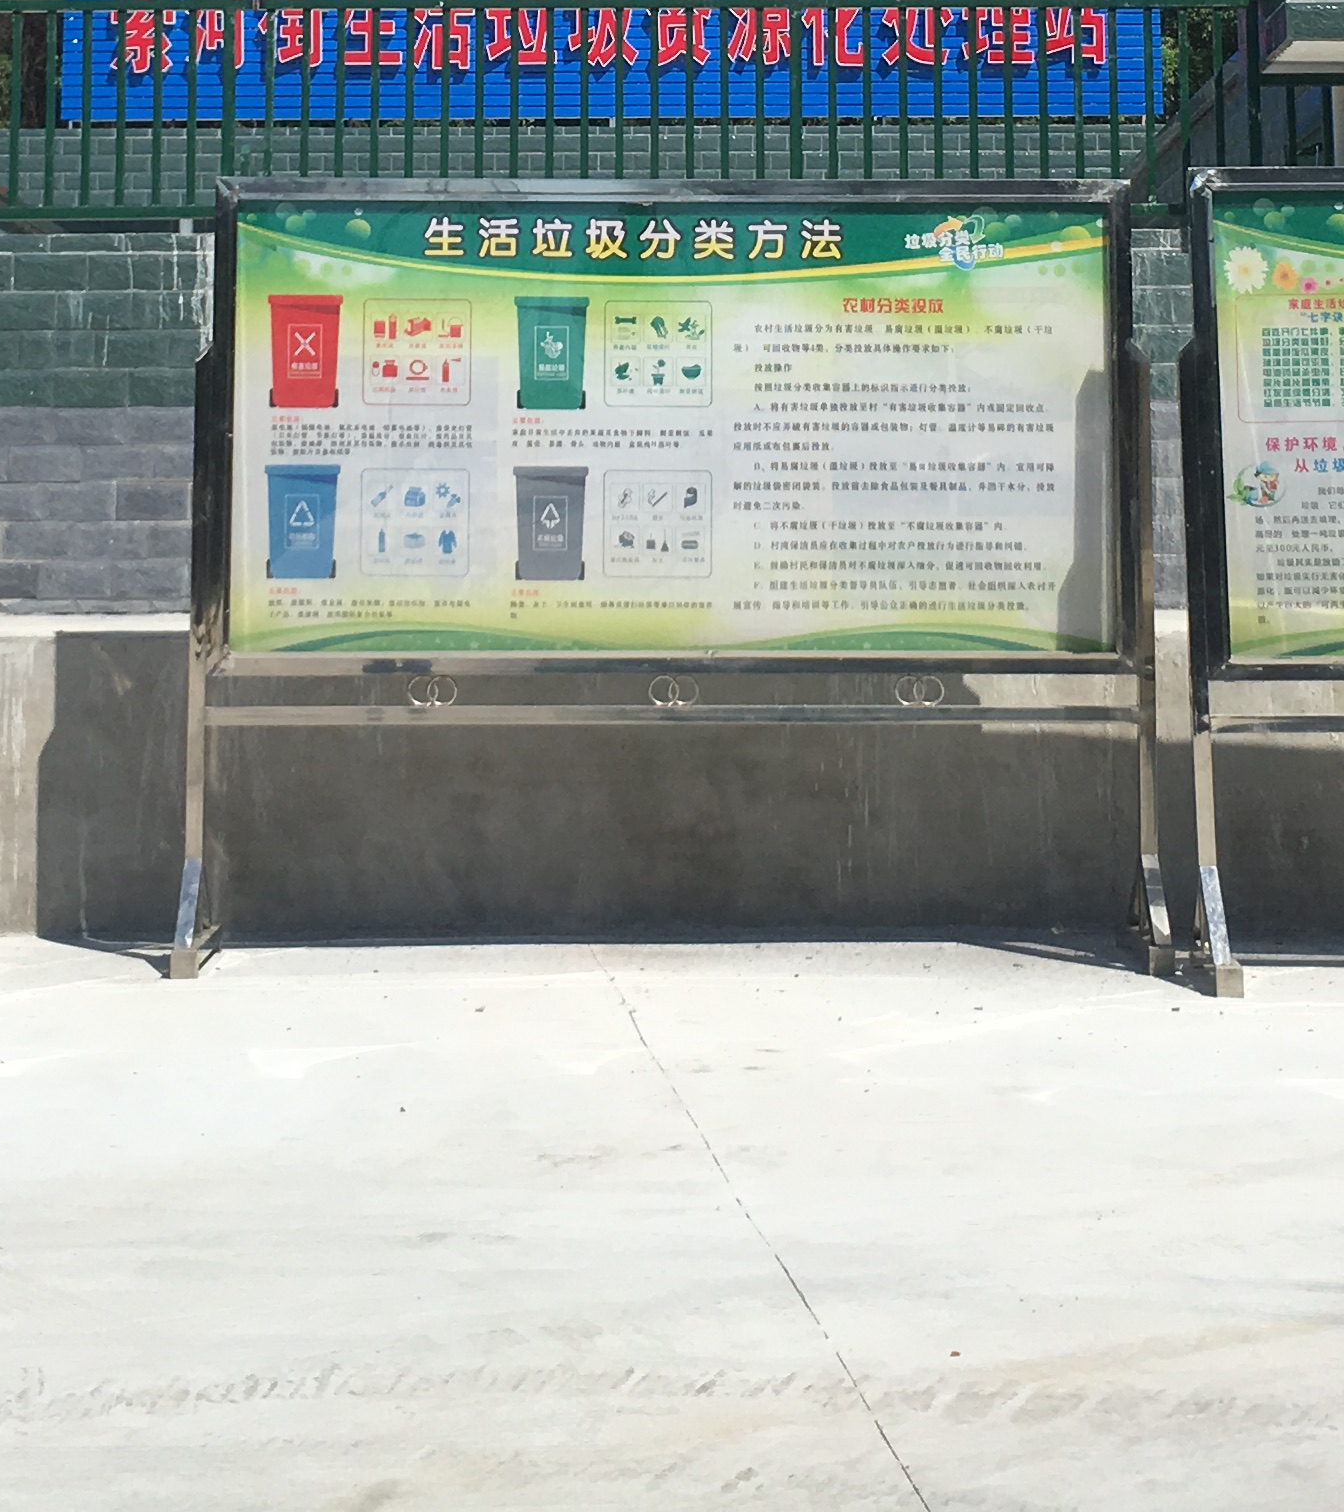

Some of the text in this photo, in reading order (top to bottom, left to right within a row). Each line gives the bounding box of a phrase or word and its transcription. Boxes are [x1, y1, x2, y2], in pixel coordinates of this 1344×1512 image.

[423, 217, 843, 260] 生活垃圾分类方法
[904, 230, 971, 249] 垃圾分类
[937, 242, 1005, 263] 全民行动
[842, 297, 944, 314] 农村分类投放
